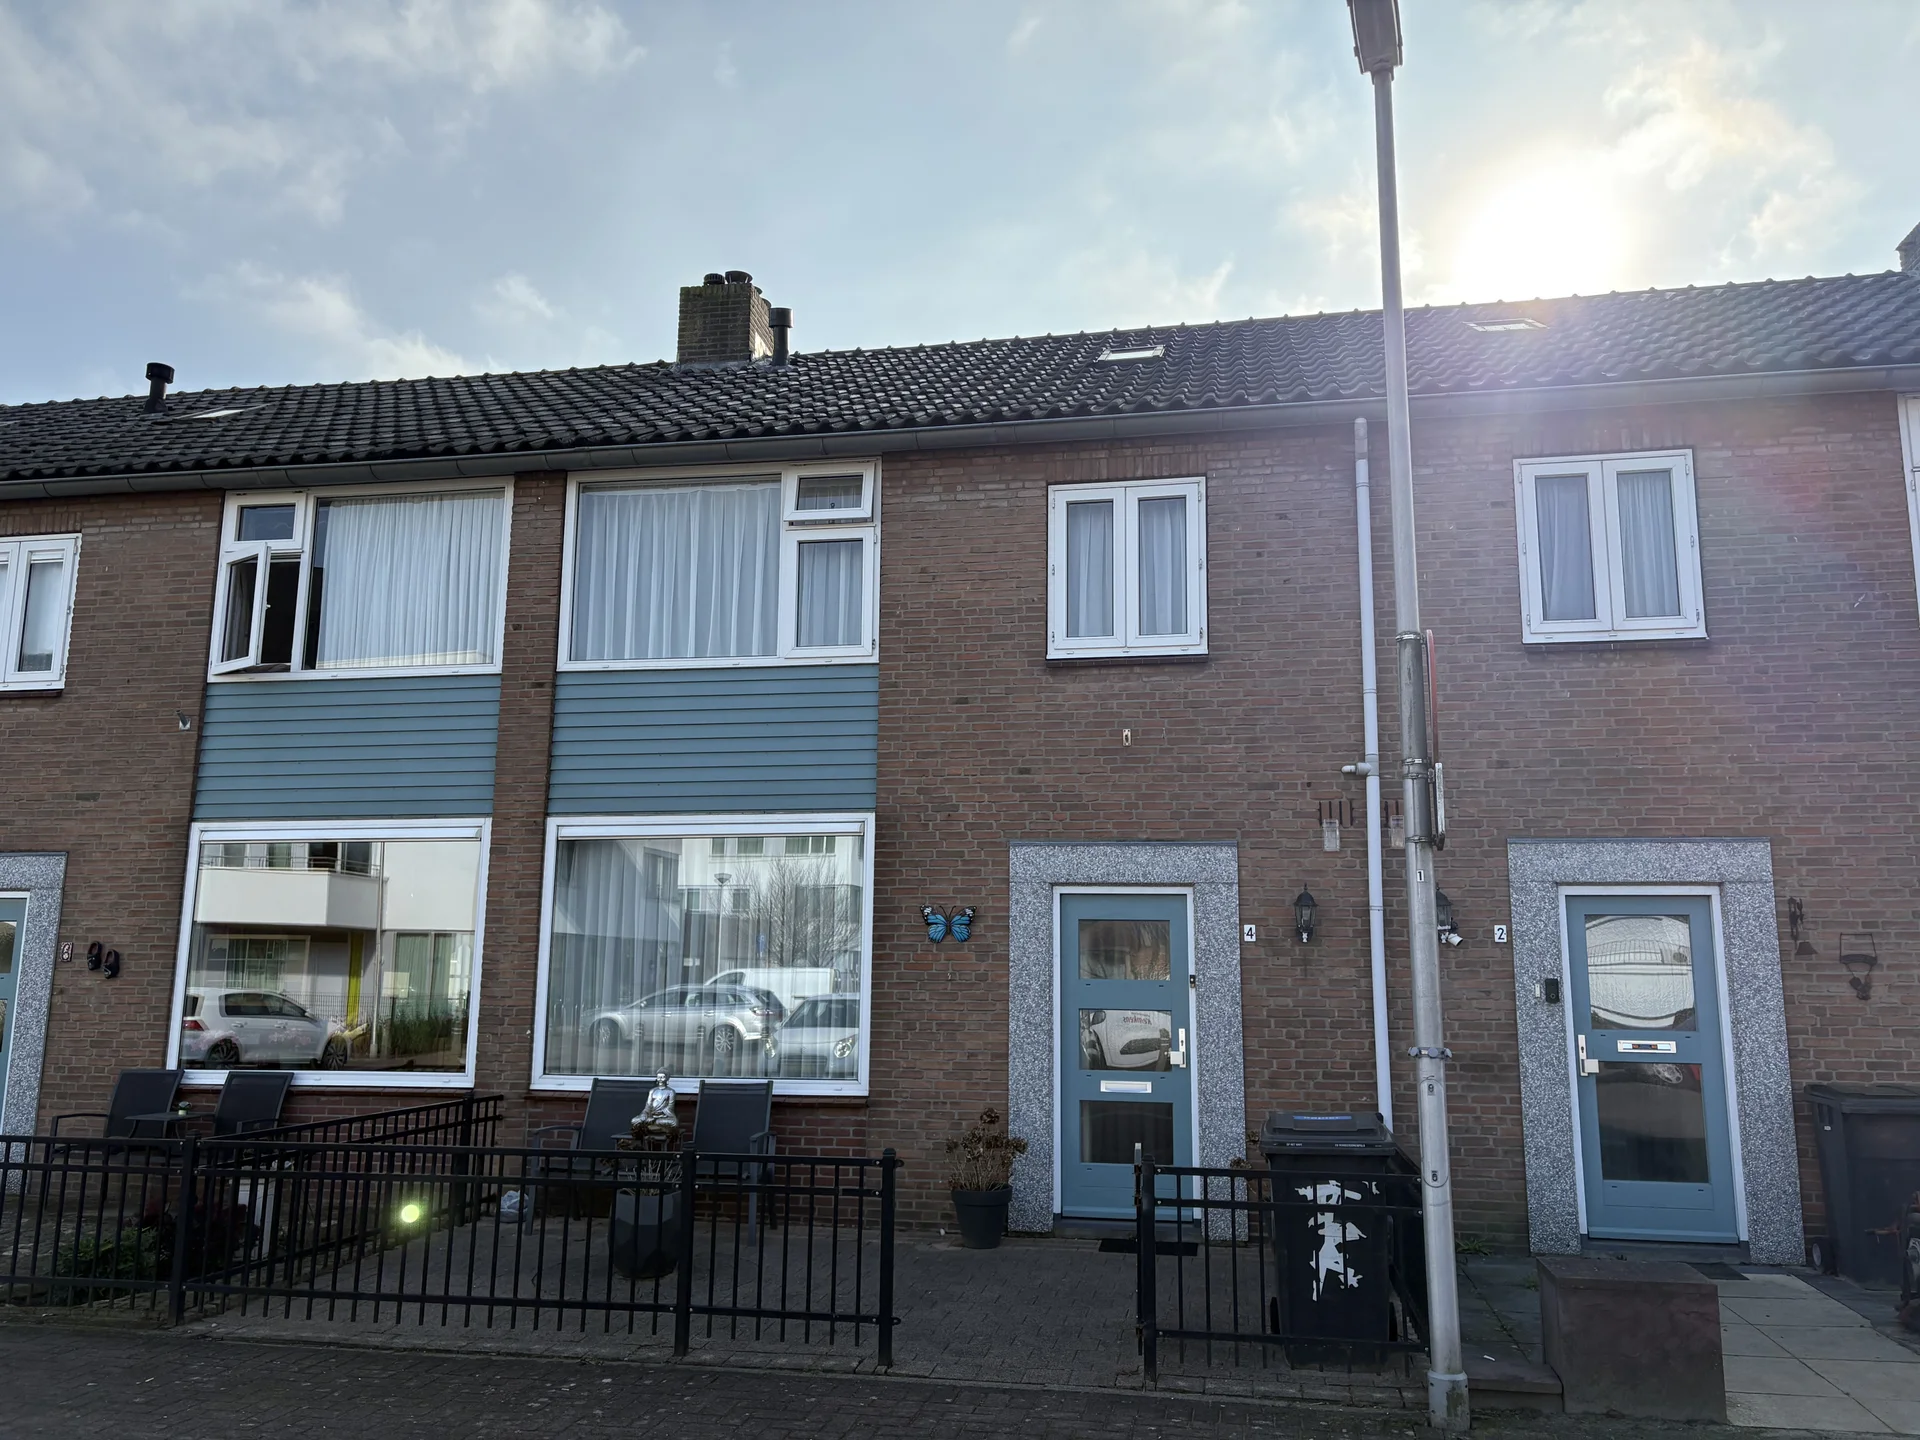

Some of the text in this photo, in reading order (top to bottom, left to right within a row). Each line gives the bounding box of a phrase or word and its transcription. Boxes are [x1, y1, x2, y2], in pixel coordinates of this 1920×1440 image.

[1417, 871, 1422, 881] 1
[1246, 926, 1254, 939] 4
[1497, 927, 1505, 940] 2
